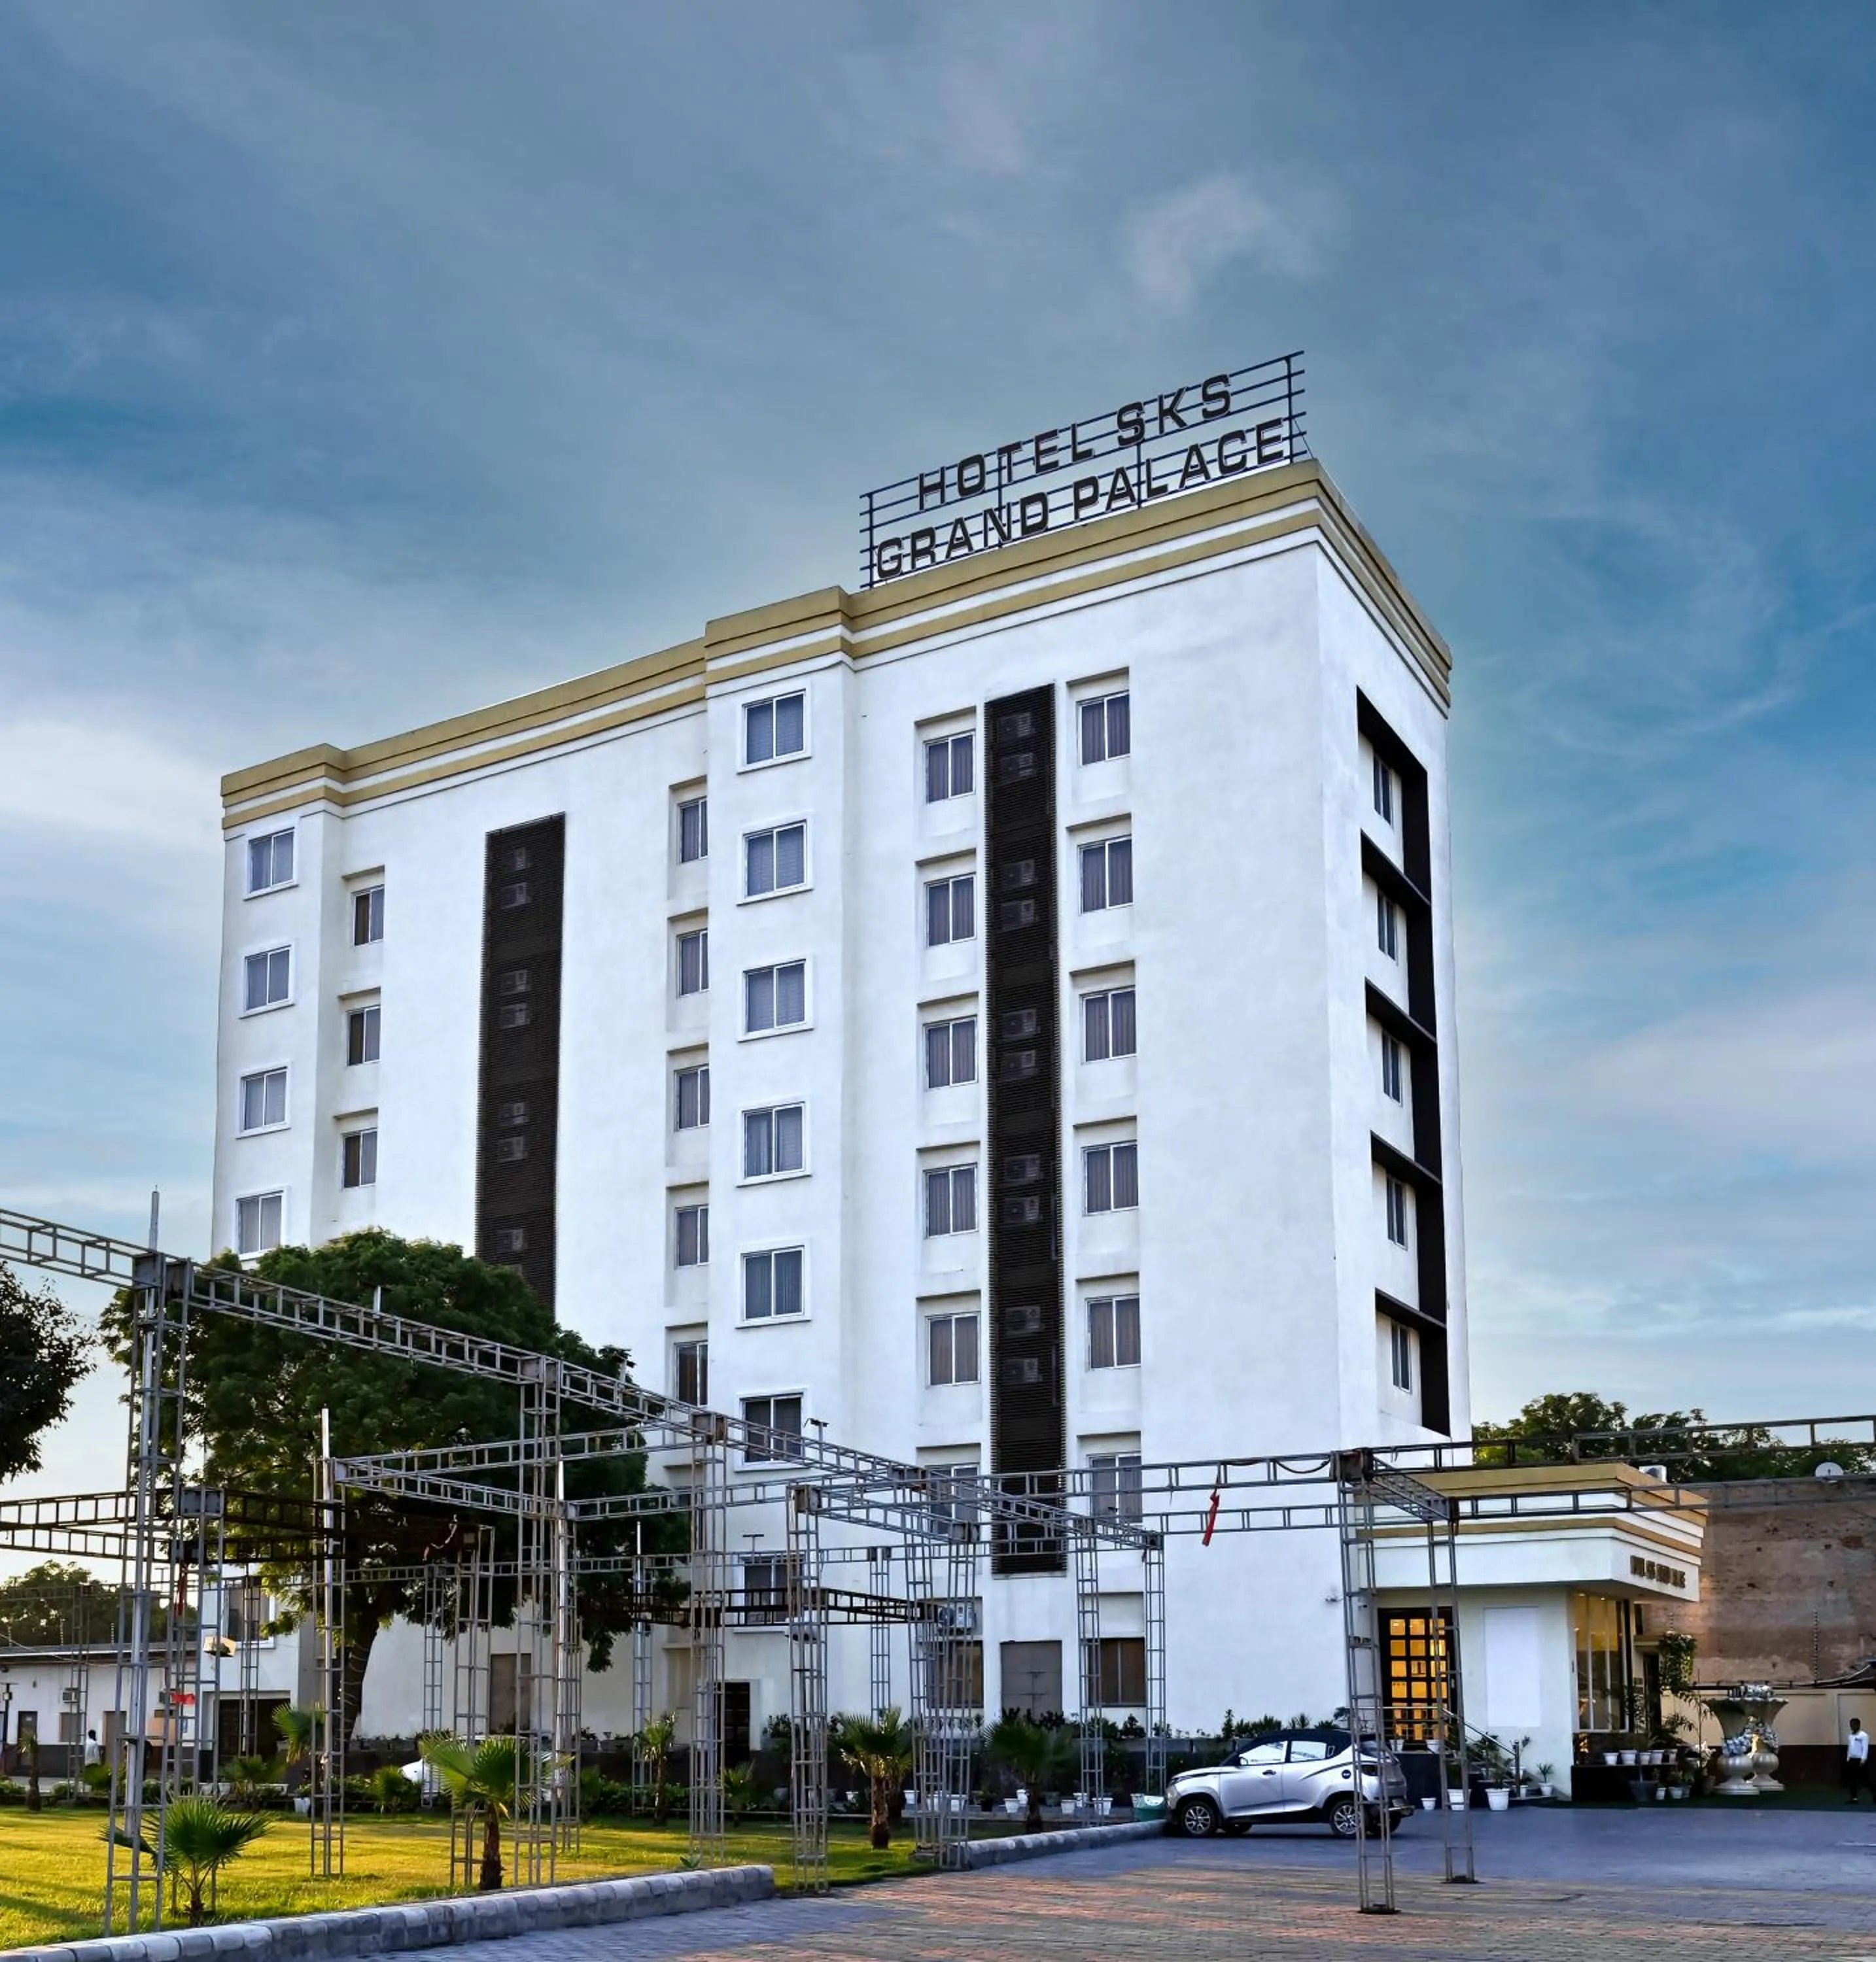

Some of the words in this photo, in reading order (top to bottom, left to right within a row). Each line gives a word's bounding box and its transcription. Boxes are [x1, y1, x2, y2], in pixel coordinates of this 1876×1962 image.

[877, 491, 1050, 579] GRAND
[1073, 417, 1287, 521] PALACE
[918, 423, 1095, 510] HOTEL
[1117, 373, 1232, 447] SKS
